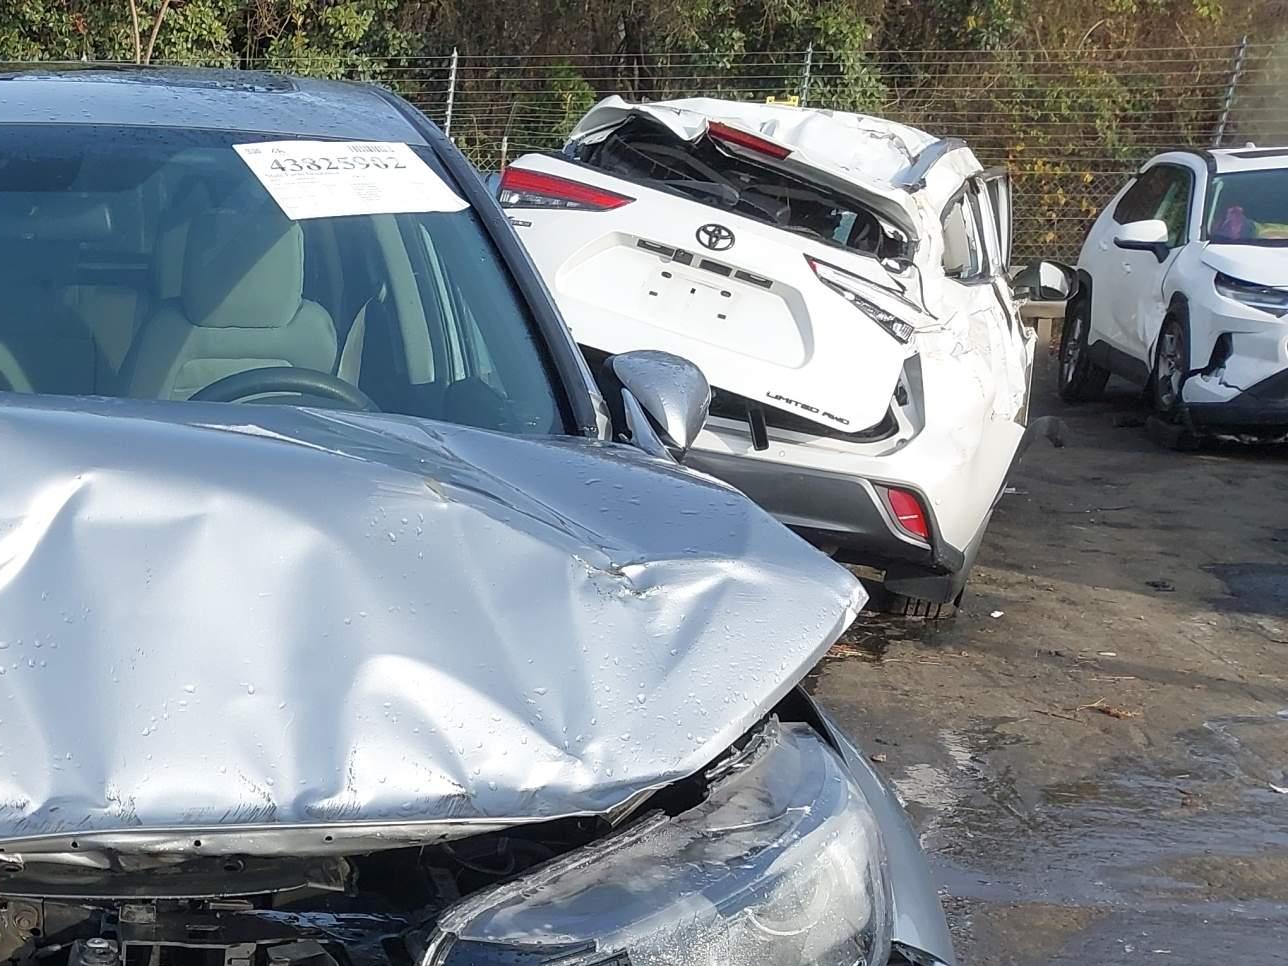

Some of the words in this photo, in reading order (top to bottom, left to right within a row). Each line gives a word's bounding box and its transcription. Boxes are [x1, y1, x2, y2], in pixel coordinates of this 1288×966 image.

[270, 156, 407, 172] 43825902
[766, 391, 819, 414] LIMITED
[822, 411, 850, 425] AWD
